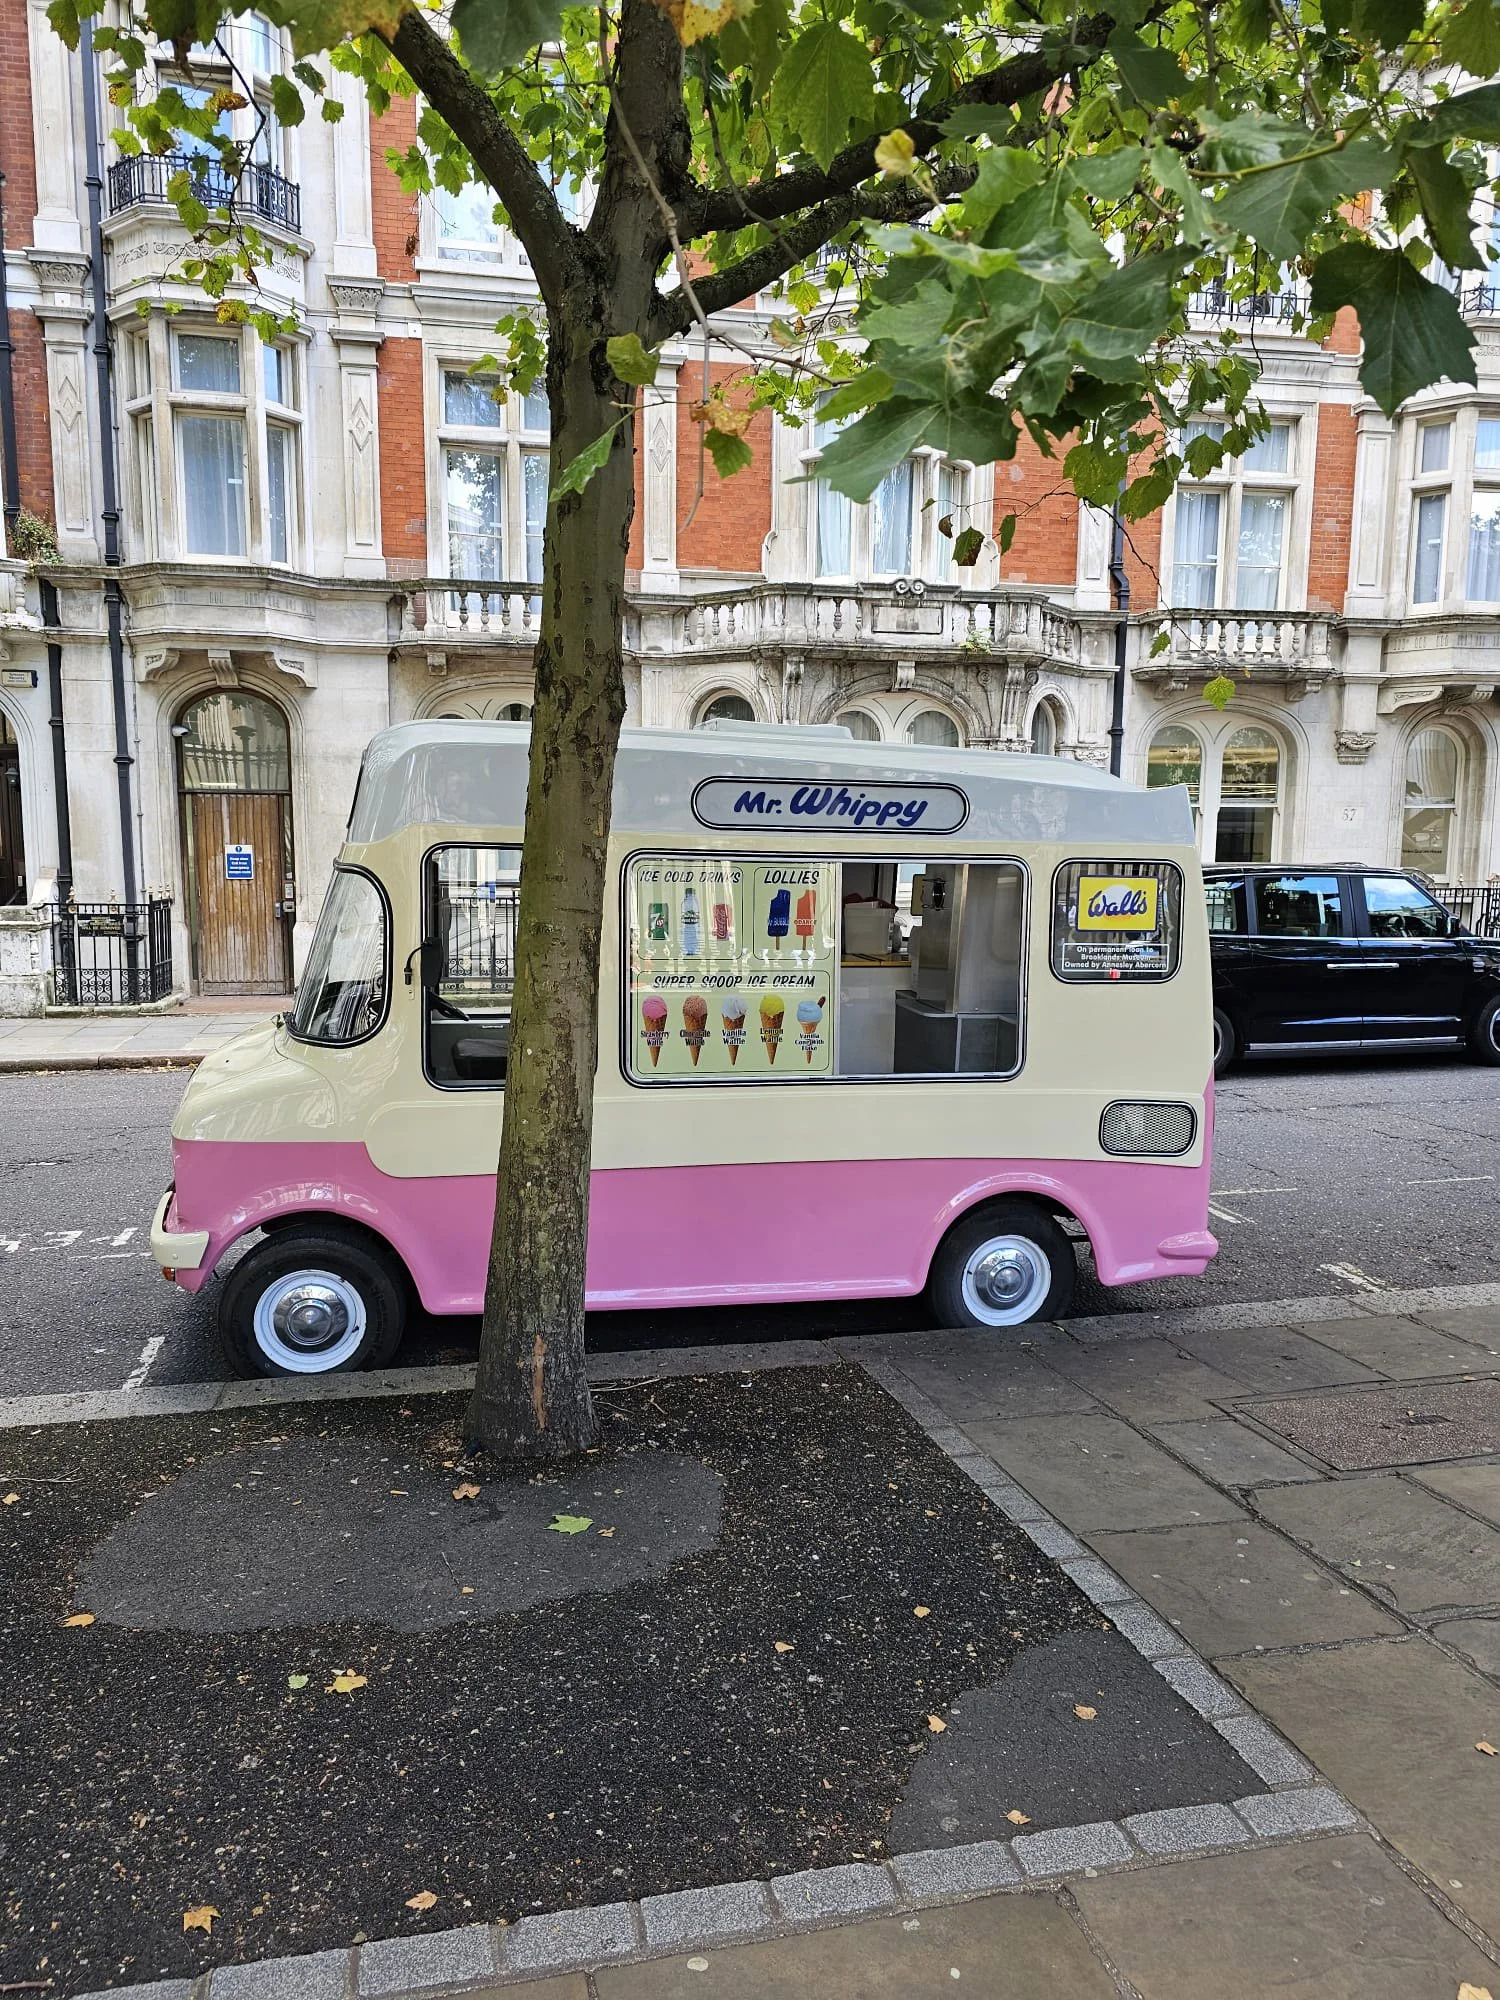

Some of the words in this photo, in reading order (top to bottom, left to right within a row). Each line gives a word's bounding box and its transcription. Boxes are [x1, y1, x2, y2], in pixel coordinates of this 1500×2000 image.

[733, 790, 782, 814] Mr.
[789, 786, 928, 827] Whippy
[1343, 808, 1357, 821] 57
[639, 870, 660, 882] ICE
[664, 870, 694, 883] COLD
[764, 870, 819, 885] LOLLIES
[1088, 890, 1147, 917] Wall's
[1088, 946, 1127, 955] permanent
[1091, 961, 1100, 969] by
[653, 975, 695, 988] SUPER
[700, 975, 743, 988] SCOOP
[747, 975, 768, 988] ICE
[772, 975, 816, 988] CREAM
[722, 1029, 747, 1037] Vanilla
[760, 1027, 784, 1035] Lemon
[723, 1037, 746, 1045] Waffle
[761, 1035, 783, 1043] Waffle
